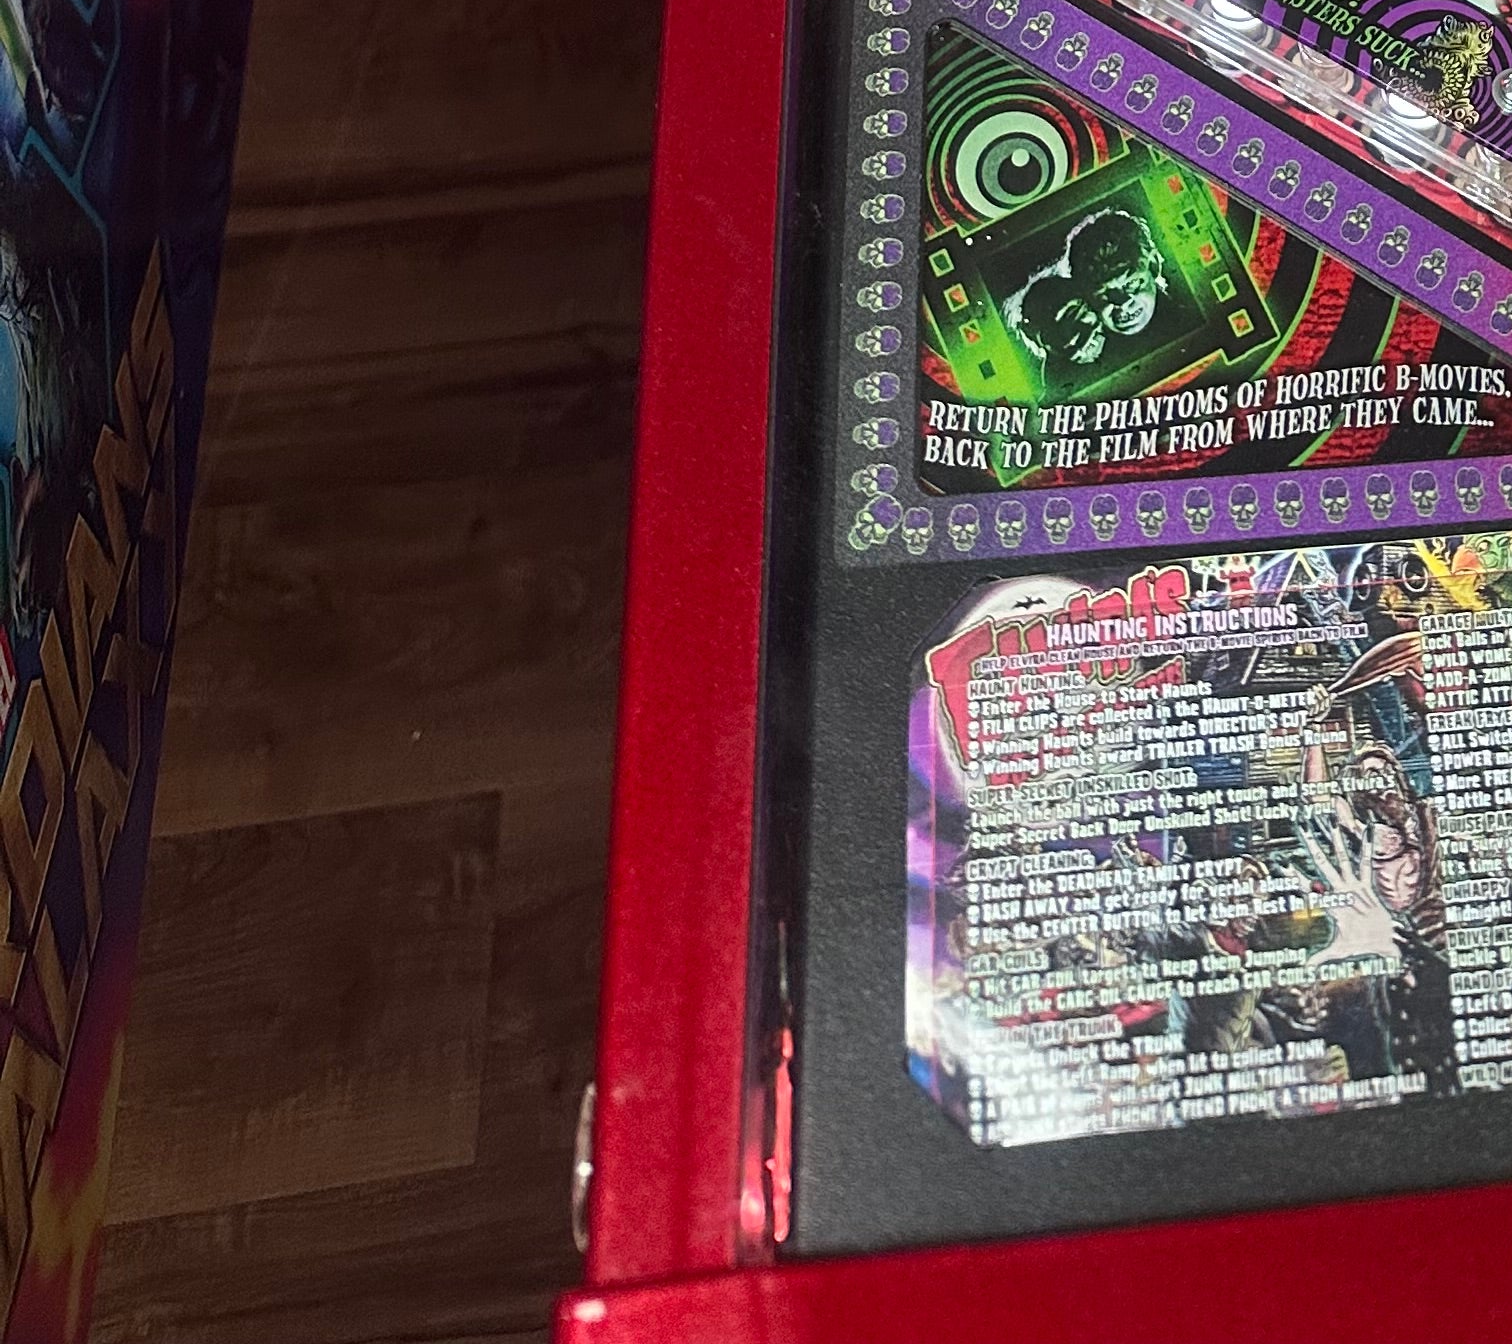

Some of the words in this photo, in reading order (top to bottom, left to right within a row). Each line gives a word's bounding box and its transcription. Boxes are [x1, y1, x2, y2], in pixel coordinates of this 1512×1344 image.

[1355, 24, 1426, 80] SUCK...
[929, 399, 1028, 435] RETURN
[1037, 397, 1088, 434] THE
[1093, 384, 1230, 431] PHANTOMS
[1235, 378, 1270, 408] OF
[1276, 365, 1388, 406] HORRIFIC
[1394, 362, 1512, 399] B-MOVIES.
[924, 433, 989, 469] BACK
[993, 441, 1032, 469] TO
[1041, 436, 1092, 468] THE
[1098, 429, 1159, 463] FILM
[1168, 419, 1235, 454] FROM
[1248, 408, 1331, 446] WHERE
[1339, 399, 1402, 432] THEY
[1412, 396, 1495, 429] CAME...
[1046, 615, 1148, 648] HAUNTING
[1154, 604, 1299, 638] INSTRUCTIONS
